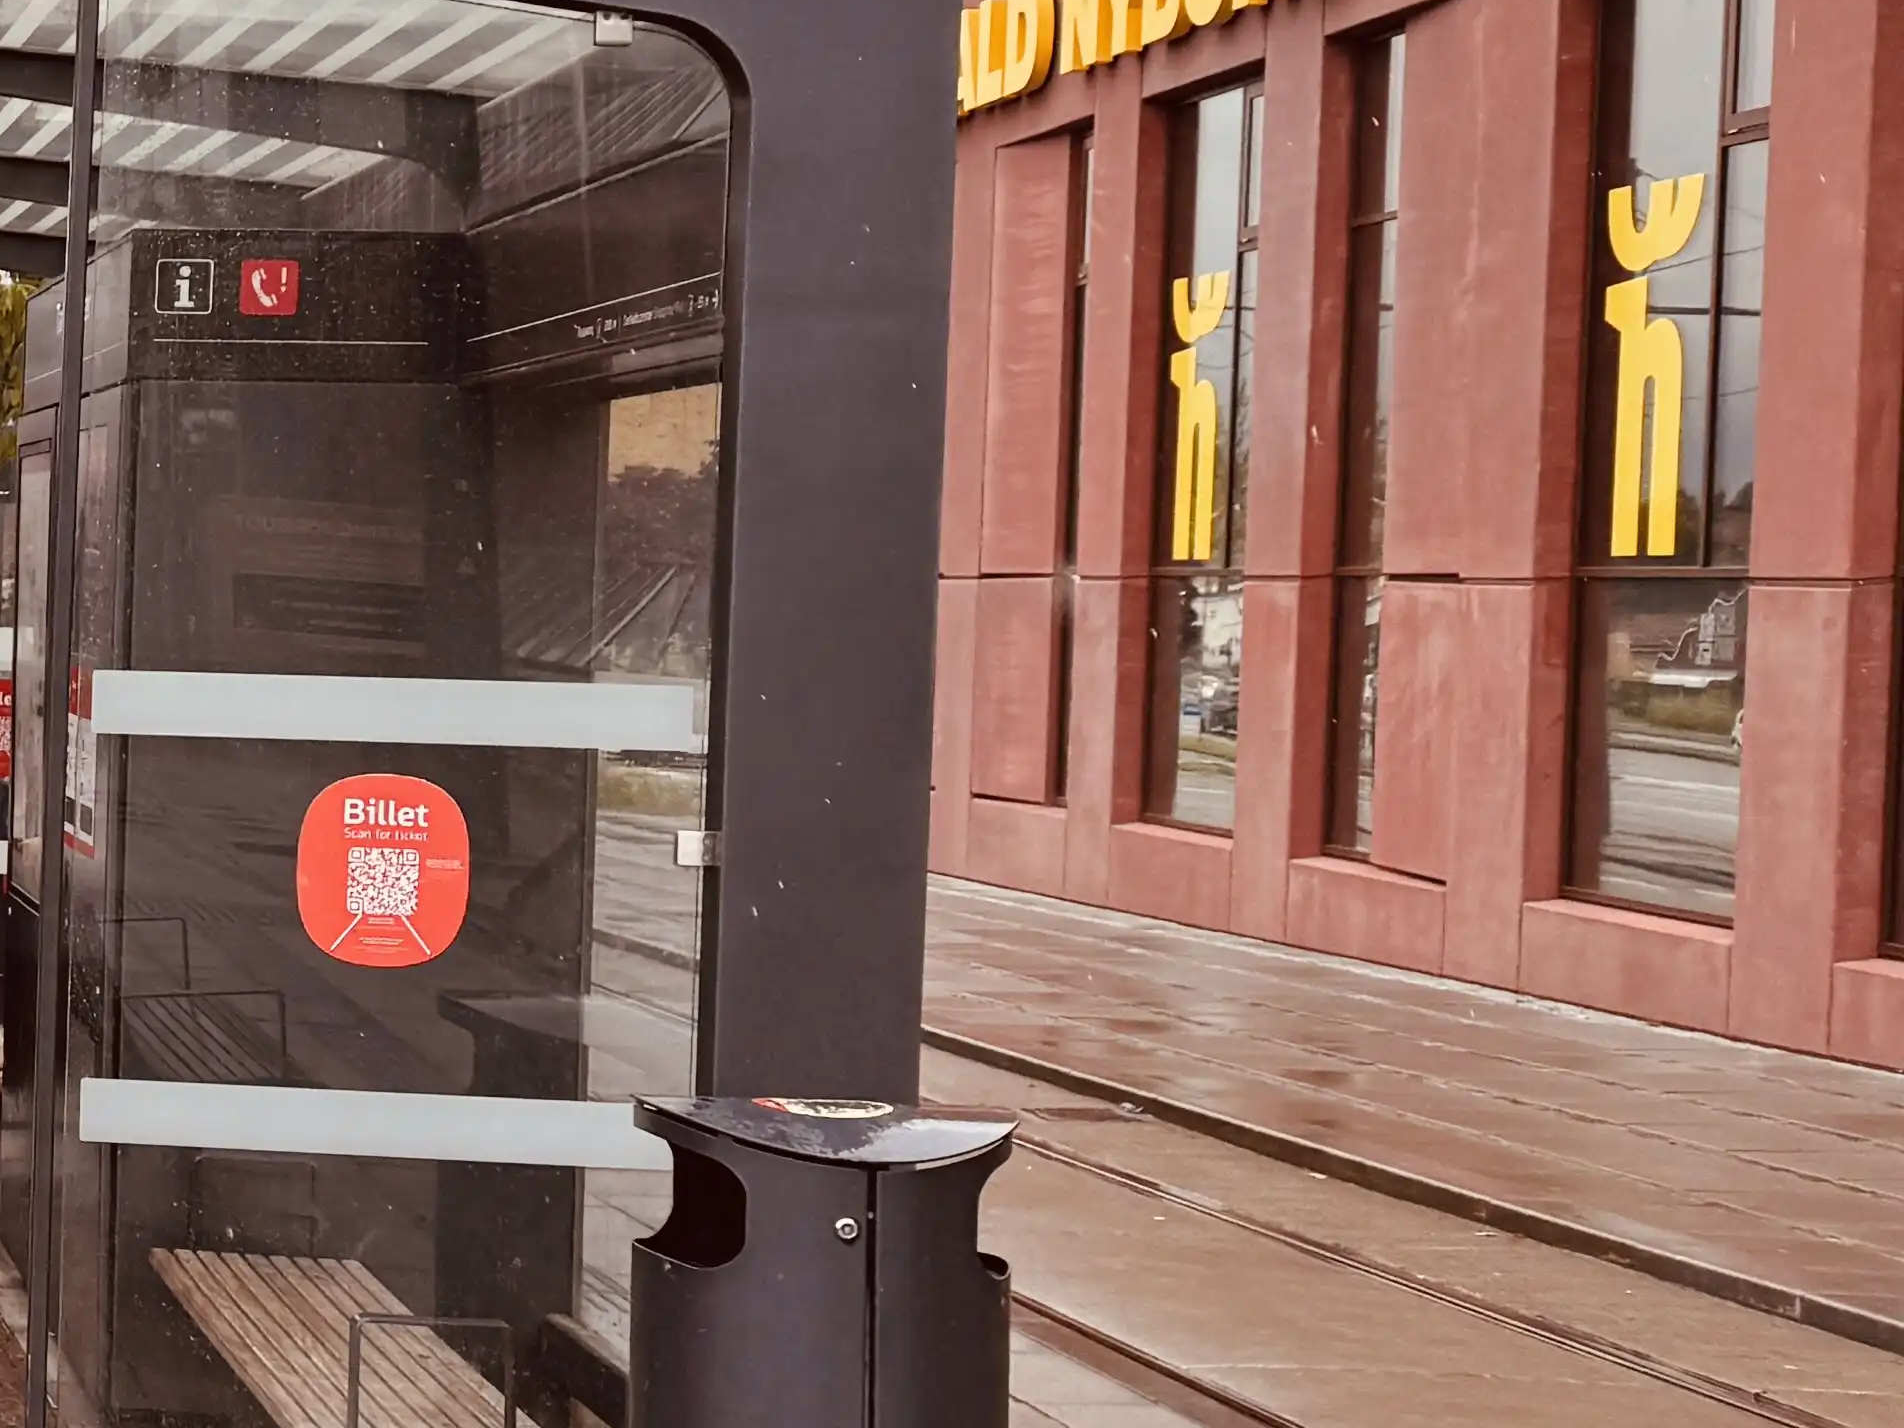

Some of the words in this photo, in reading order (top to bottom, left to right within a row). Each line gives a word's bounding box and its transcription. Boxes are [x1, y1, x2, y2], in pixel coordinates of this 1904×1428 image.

[344, 797, 430, 828] Billet
[343, 827, 372, 840] Scan
[376, 828, 392, 840] for
